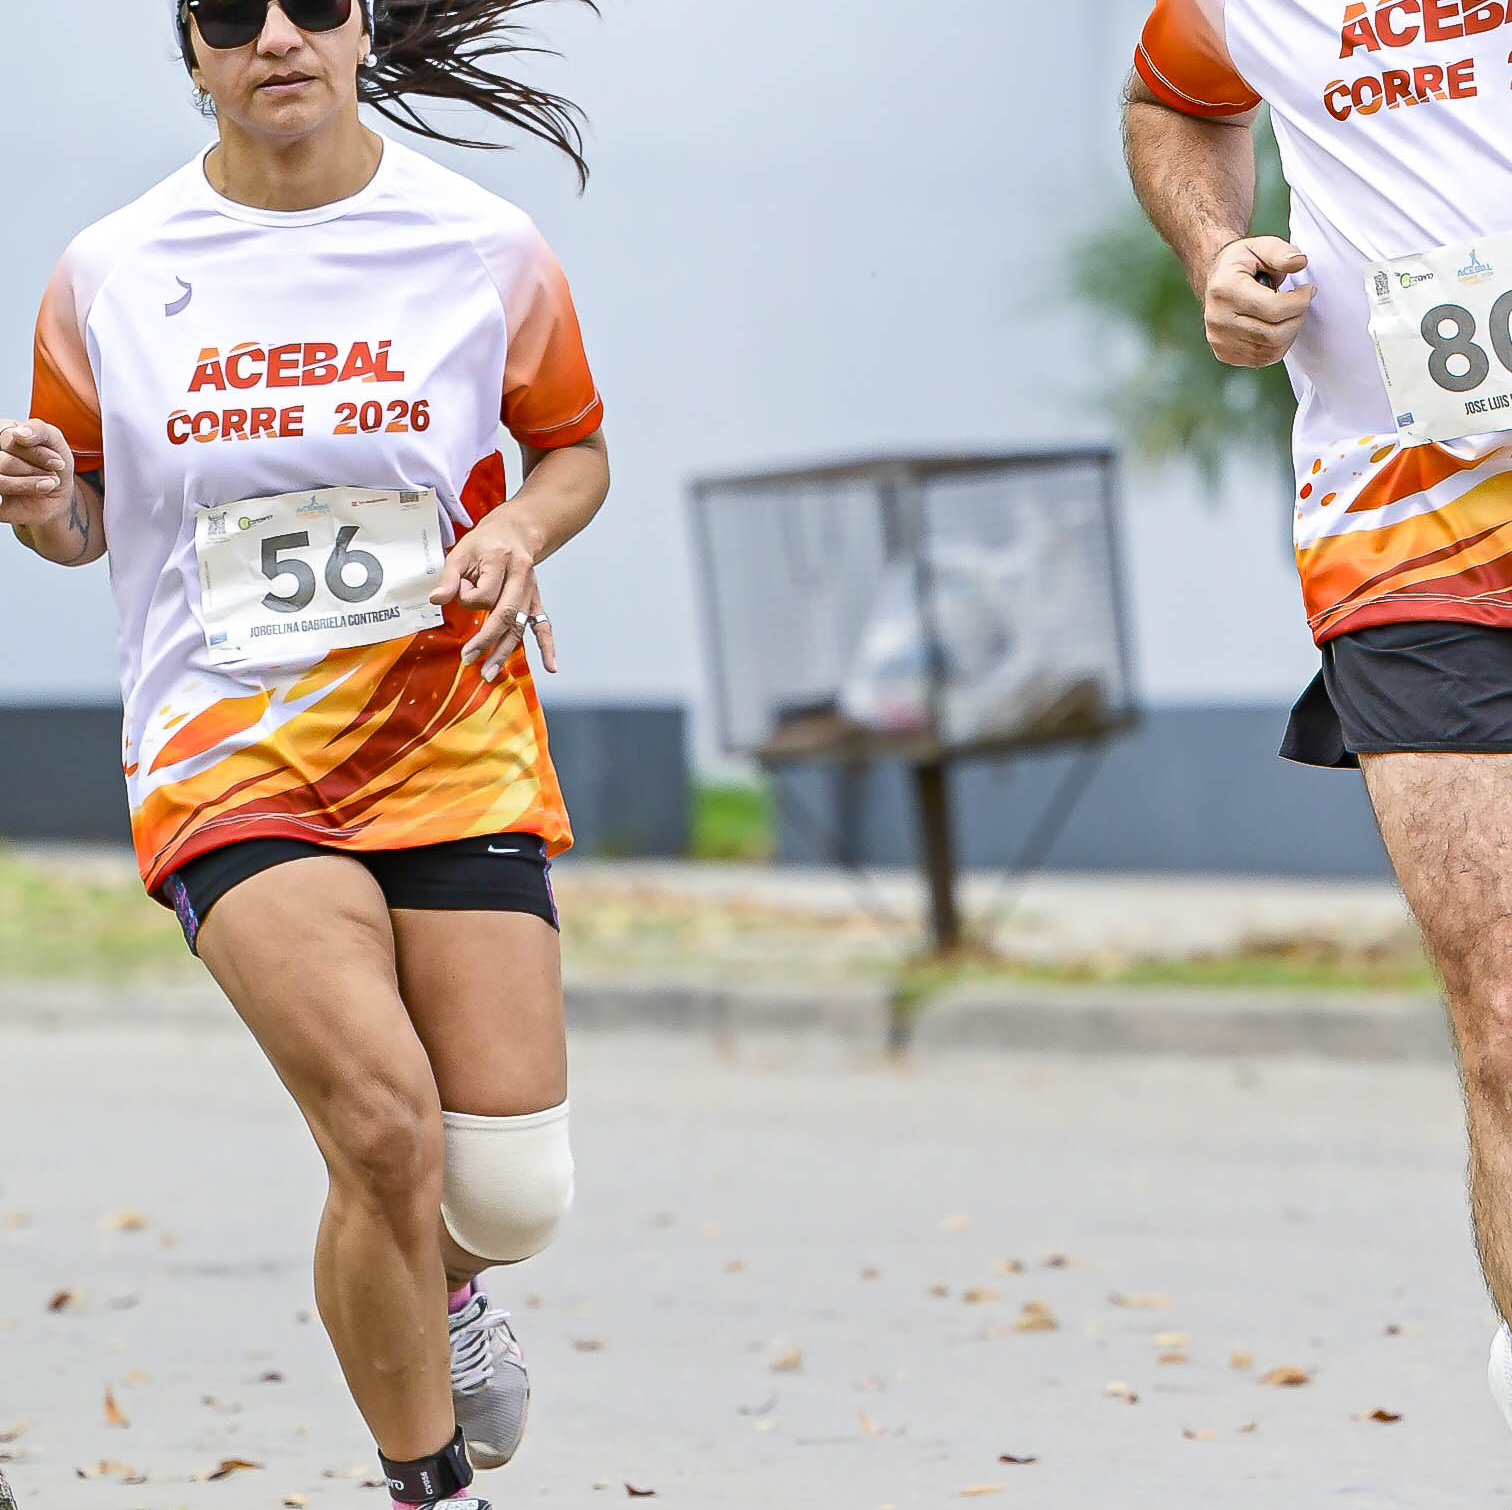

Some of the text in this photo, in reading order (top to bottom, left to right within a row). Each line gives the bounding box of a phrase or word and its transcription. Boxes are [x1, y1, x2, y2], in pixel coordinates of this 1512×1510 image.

[1323, 58, 1478, 122] CORRE
[187, 339, 405, 393] ACEBAL
[166, 399, 430, 445] CORRE 2026
[1464, 399, 1489, 416] JOSE
[1488, 394, 1510, 410] LUIS
[261, 525, 384, 613] 56
[250, 606, 401, 638] JORGELINA GABRIELA CONTRERAS
